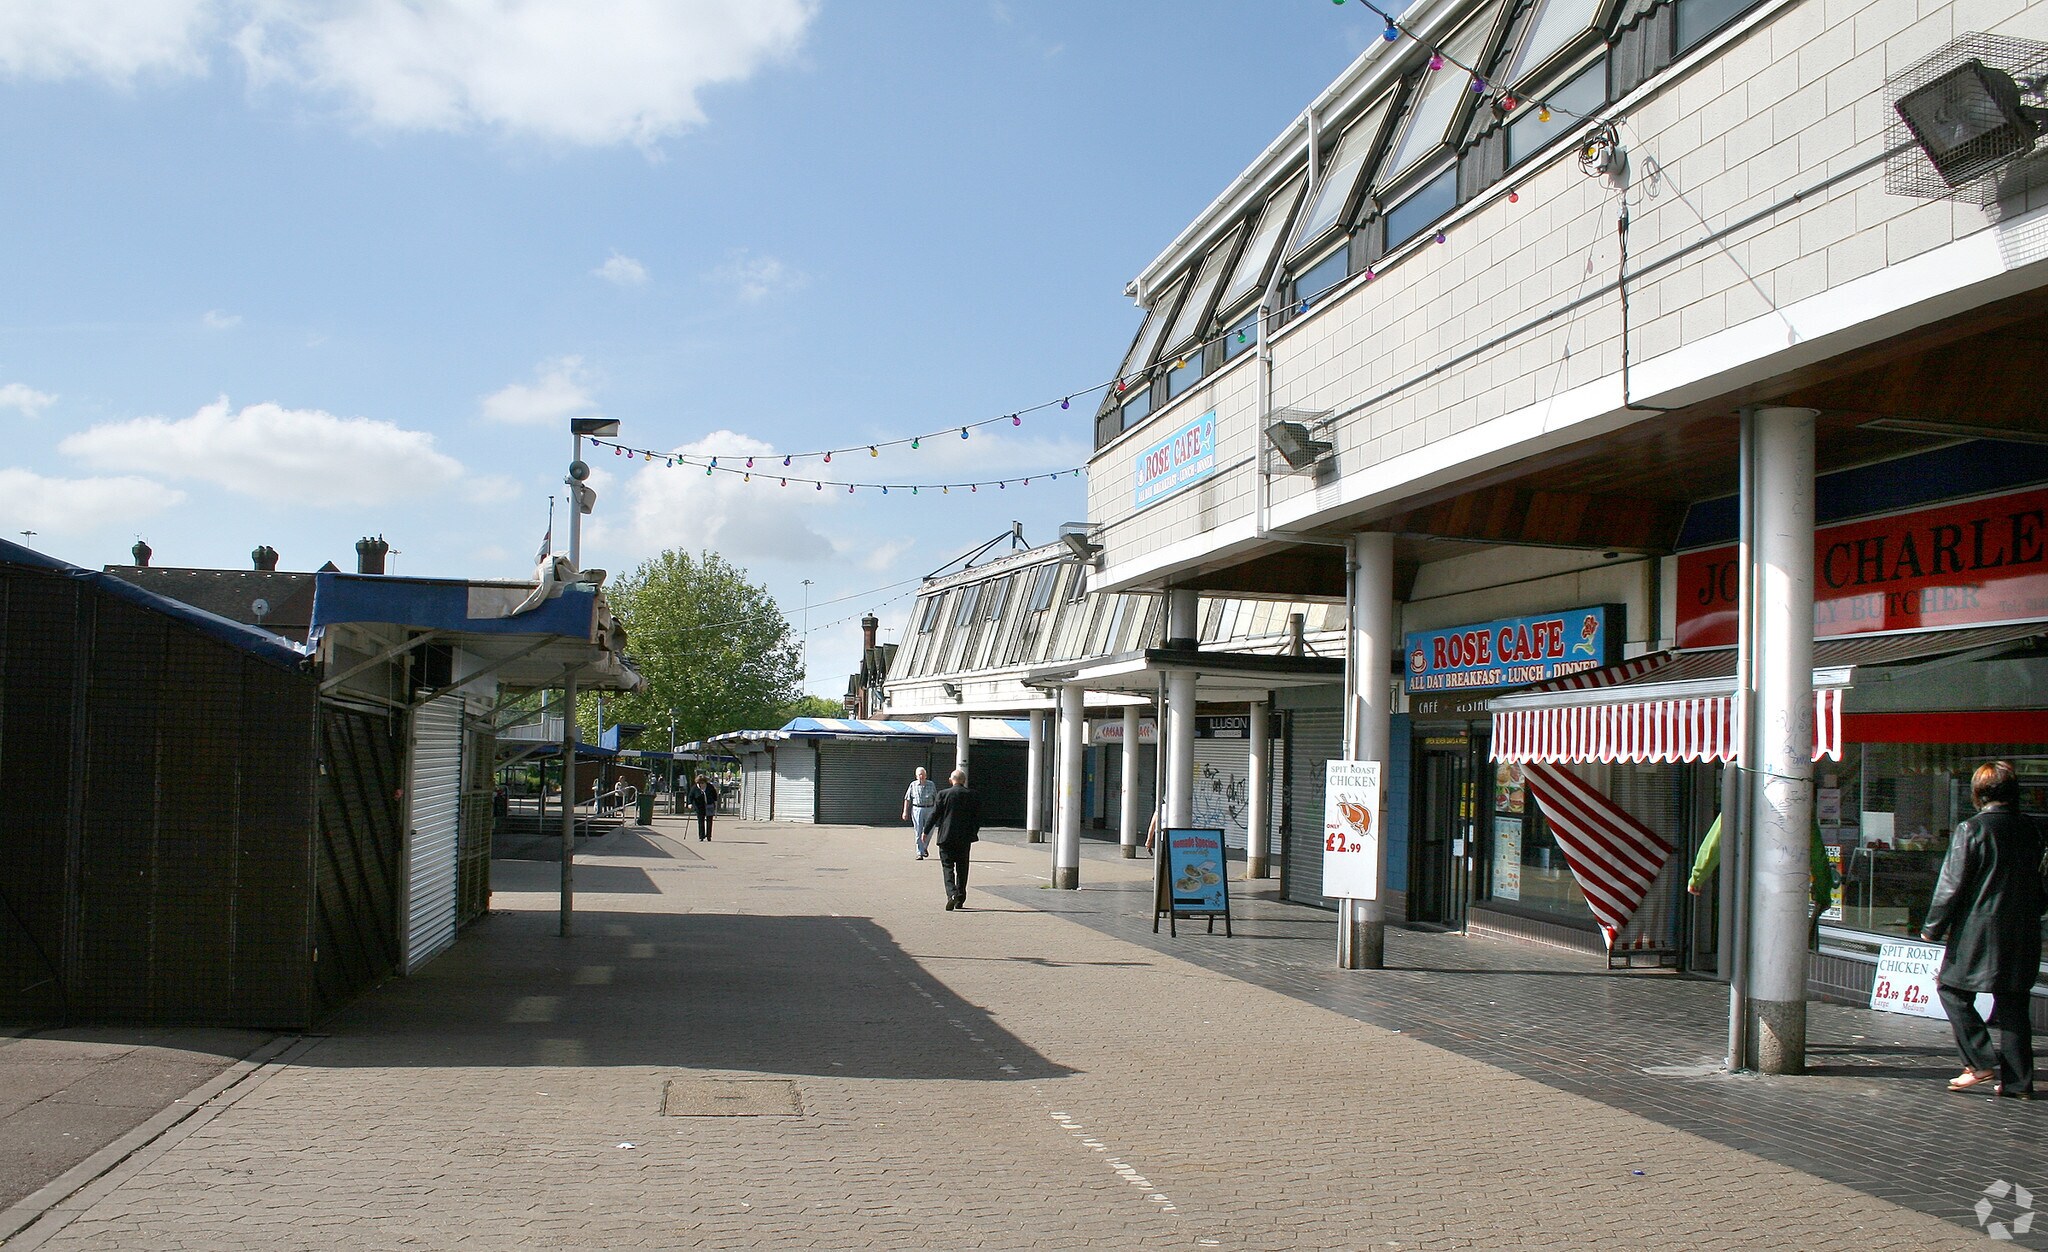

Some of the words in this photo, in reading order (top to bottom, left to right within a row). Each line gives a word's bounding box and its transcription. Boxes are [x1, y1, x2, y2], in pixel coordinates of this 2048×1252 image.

[1145, 443, 1170, 482] ROSE
[1173, 426, 1201, 467] CAFE
[1823, 510, 2043, 589] CHARLE
[1850, 583, 1980, 621] BUTCHER
[1432, 631, 1492, 670] ROSE
[1496, 619, 1565, 664] CAFE
[1409, 675, 1425, 690] ALL
[1426, 674, 1444, 689] DAY
[1445, 669, 1501, 687] BREAKFAST
[1508, 665, 1544, 683] LUNCH
[1209, 717, 1248, 729] ILLUSION
[1330, 775, 1377, 787] CHICKEN
[1351, 766, 1376, 774] ROAST
[1326, 832, 1361, 853] £2.99
[1882, 945, 1905, 957] SPIT
[1906, 947, 1941, 960] ROAST
[1879, 959, 1929, 974] CHICKEN
[1875, 981, 1899, 999] £3.99
[1903, 984, 1929, 1004] £2.99
